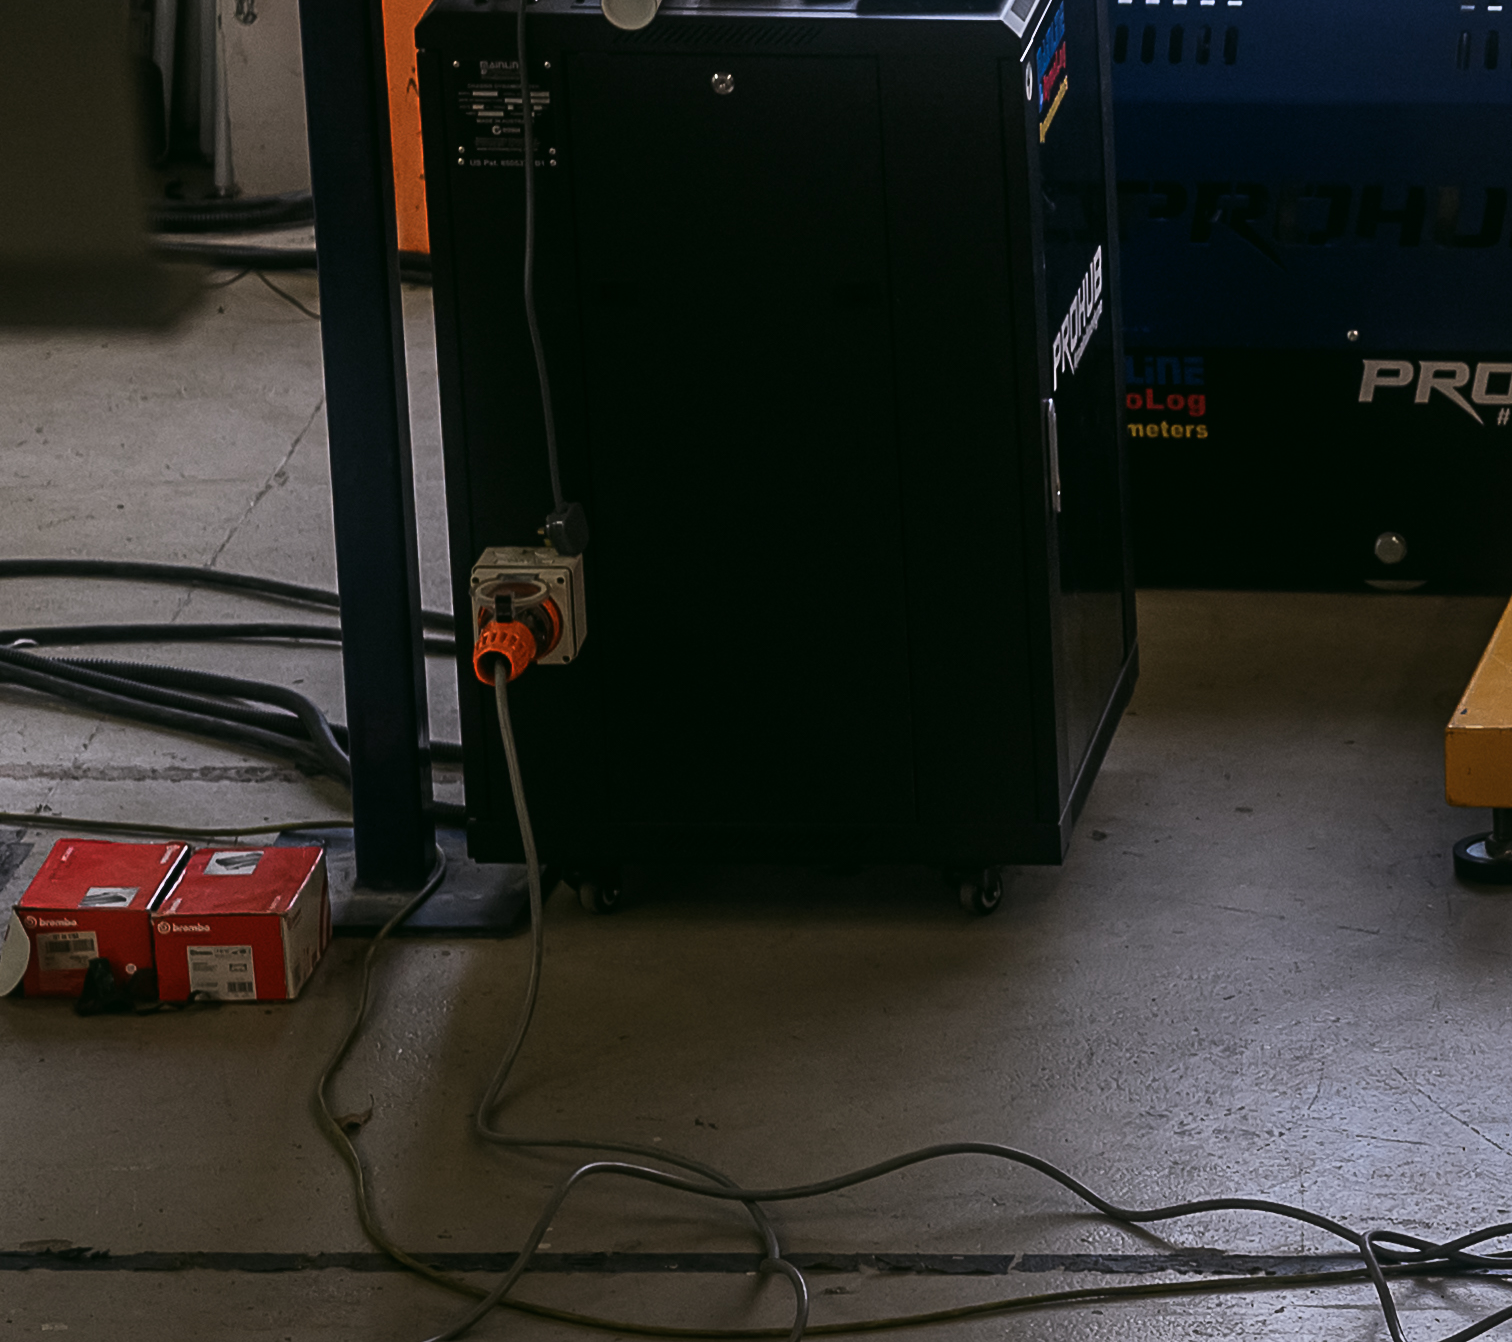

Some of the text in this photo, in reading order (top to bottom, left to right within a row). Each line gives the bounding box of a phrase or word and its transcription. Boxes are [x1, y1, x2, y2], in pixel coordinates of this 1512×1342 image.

[1052, 244, 1103, 392] PROHUB
[1125, 355, 1205, 386] LINE
[1126, 387, 1207, 418] oLog
[1126, 419, 1209, 439] meters
[38, 917, 79, 928] brembo
[172, 923, 212, 933] brembo
